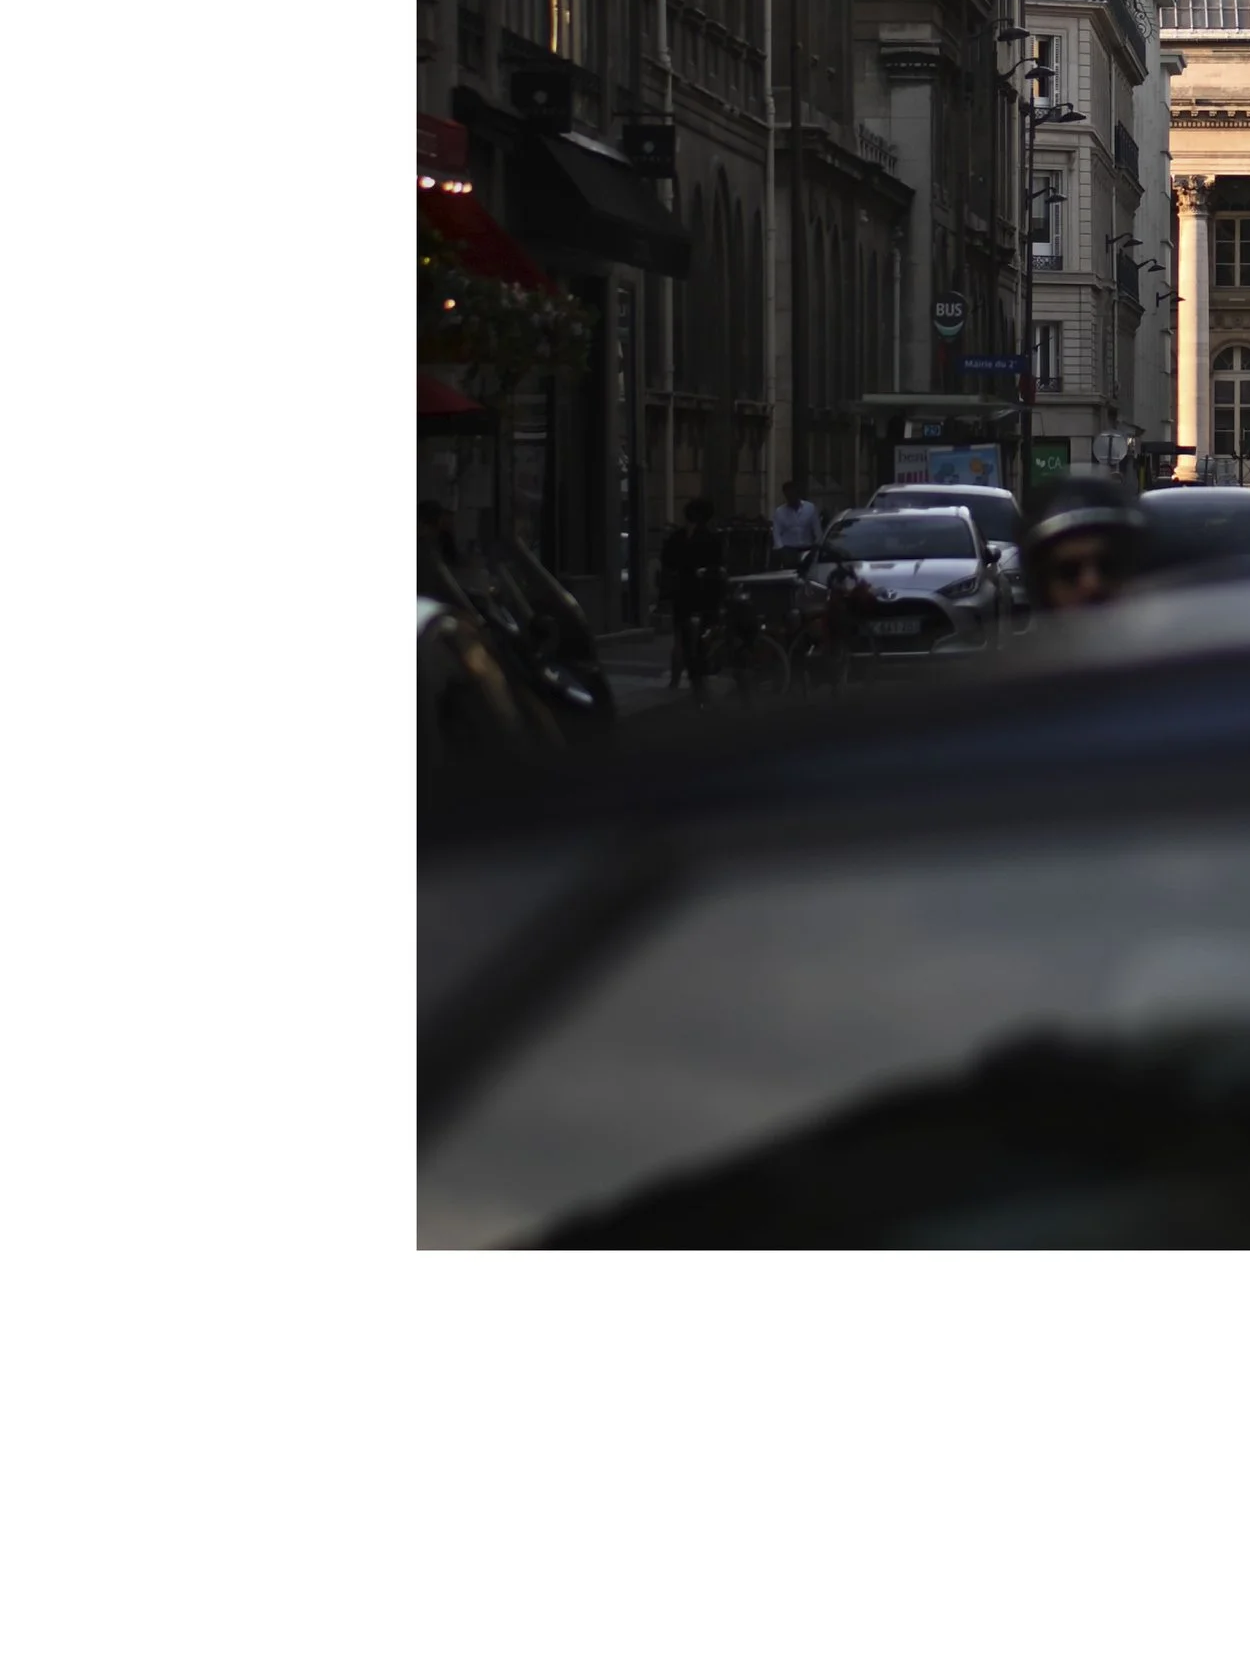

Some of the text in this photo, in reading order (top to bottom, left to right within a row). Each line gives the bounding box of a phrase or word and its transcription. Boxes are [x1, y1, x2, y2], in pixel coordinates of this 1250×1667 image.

[936, 302, 963, 317] BUS
[964, 359, 993, 369] Mairie
[995, 359, 1006, 369] du
